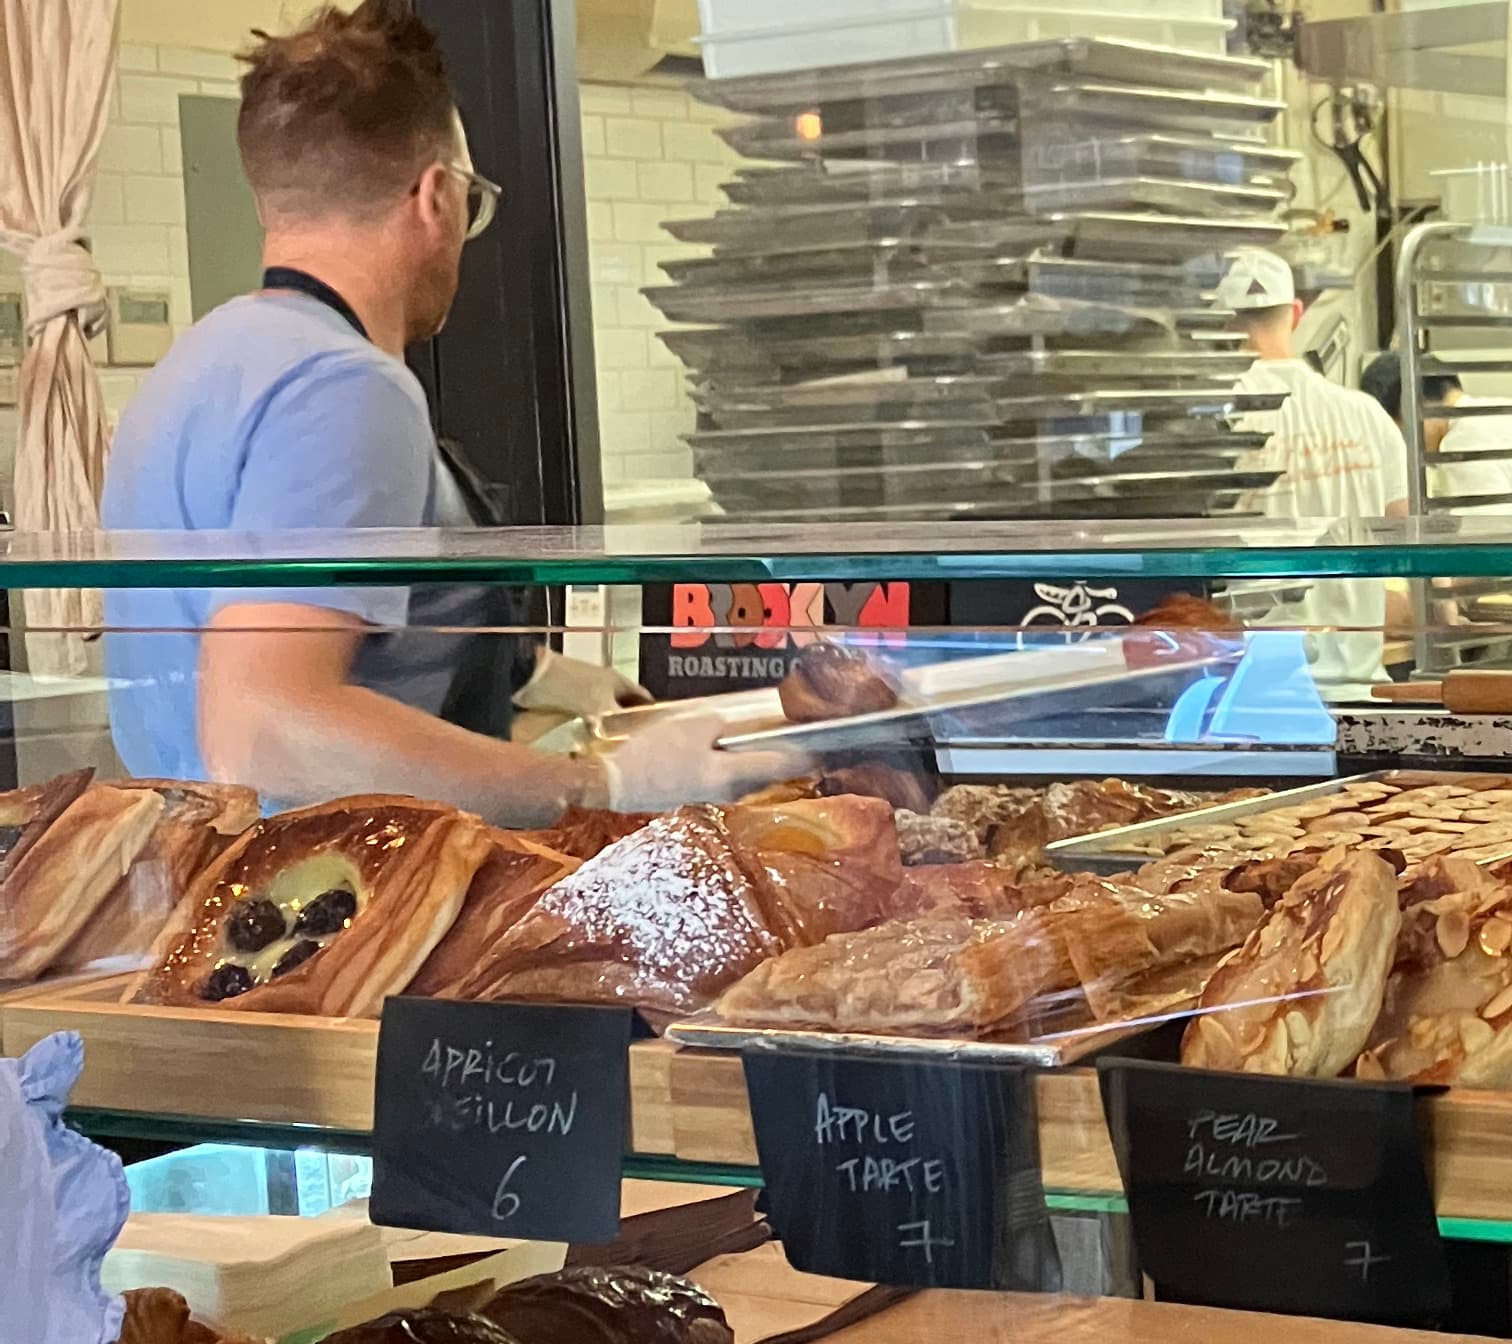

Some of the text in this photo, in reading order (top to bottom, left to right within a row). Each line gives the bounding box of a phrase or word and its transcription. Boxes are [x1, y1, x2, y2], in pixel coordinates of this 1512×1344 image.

[667, 656, 785, 678] ROASTING
[815, 1092, 916, 1145] APPLE
[1187, 1112, 1300, 1146] PEAR
[836, 1156, 946, 1194] TARTE
[1183, 1144, 1329, 1187] ALMOND
[491, 1156, 527, 1221] 6
[896, 1220, 954, 1264] 7
[1343, 1241, 1393, 1281] 7
